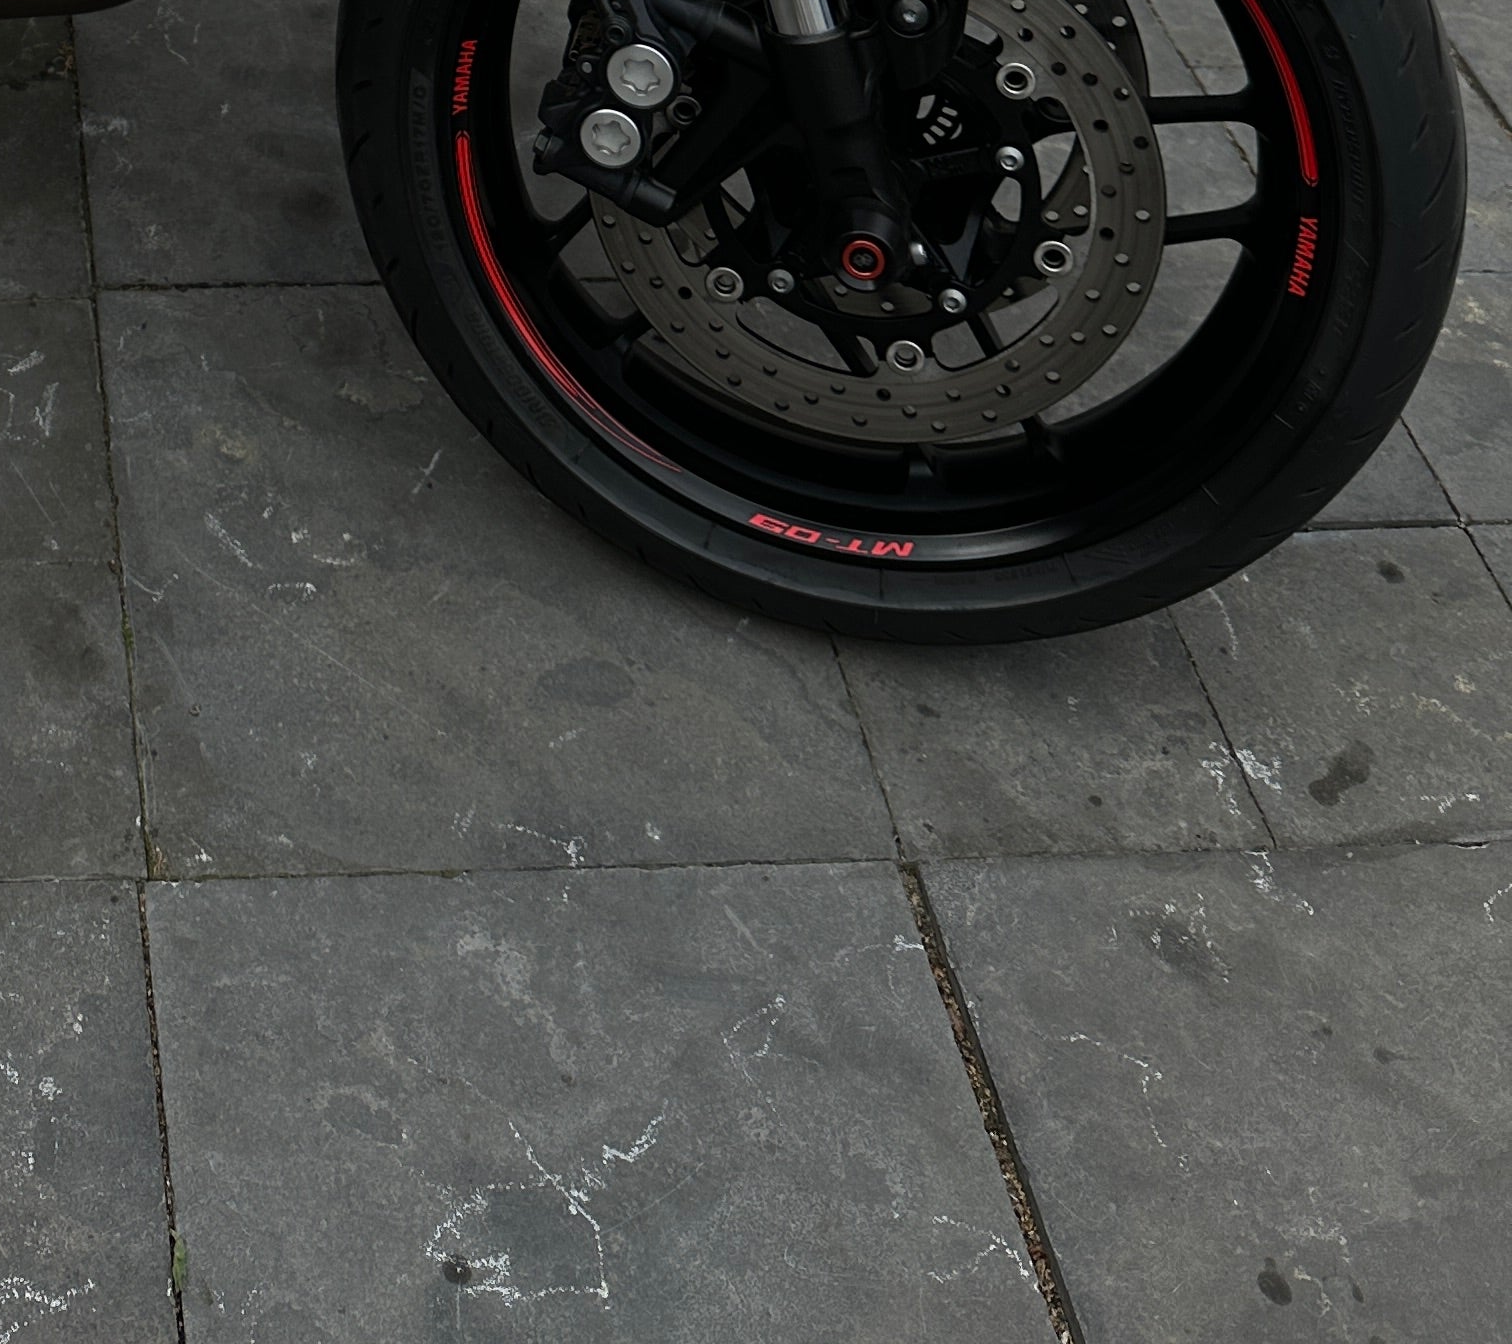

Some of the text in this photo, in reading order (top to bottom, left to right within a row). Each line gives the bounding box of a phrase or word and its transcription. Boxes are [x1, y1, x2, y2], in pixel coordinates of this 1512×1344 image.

[451, 39, 477, 114] YAMAHA
[1288, 217, 1319, 297] YAMAHA
[749, 512, 915, 558] MT-09
